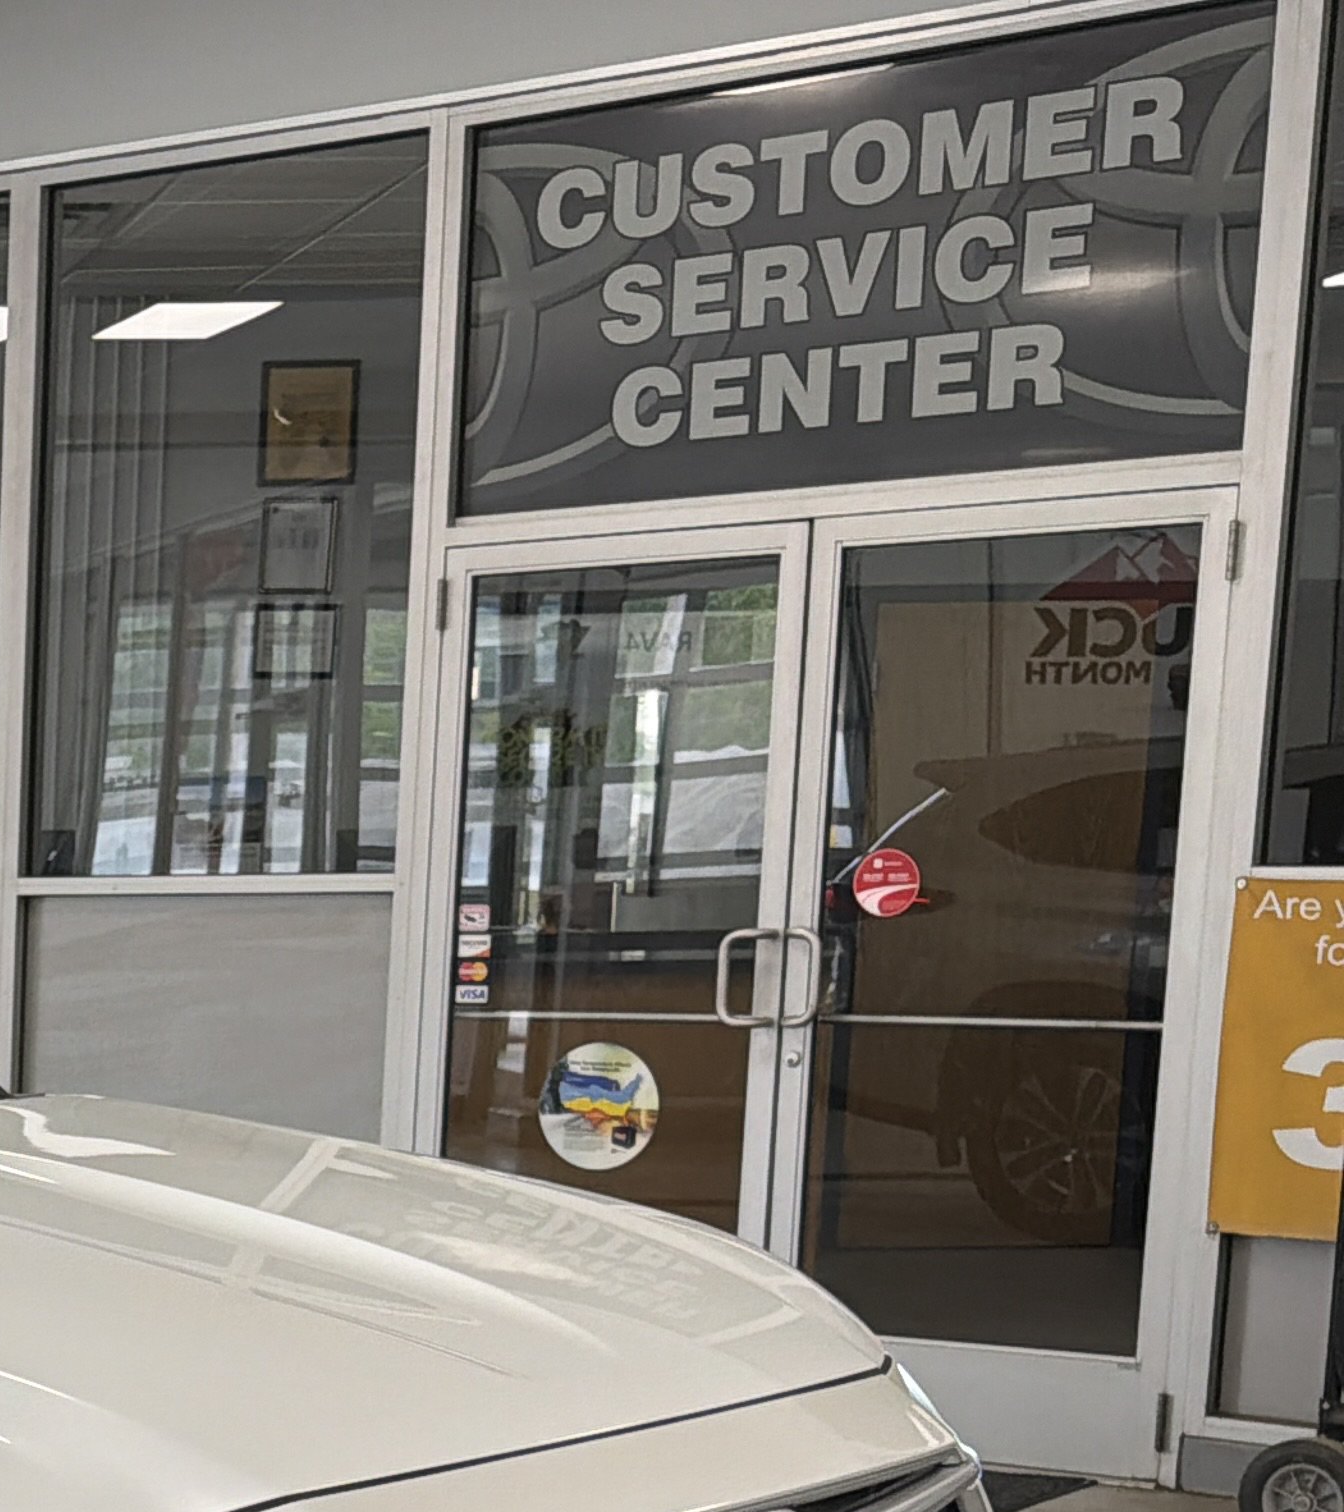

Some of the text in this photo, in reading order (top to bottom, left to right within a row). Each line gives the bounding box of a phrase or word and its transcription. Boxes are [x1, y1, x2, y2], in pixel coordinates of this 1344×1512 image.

[535, 75, 1184, 251] CUSTOMER
[598, 201, 1095, 347] SERVICE
[610, 321, 1067, 449] CENTER
[1253, 889, 1322, 921] Are
[460, 990, 486, 999] VISA
